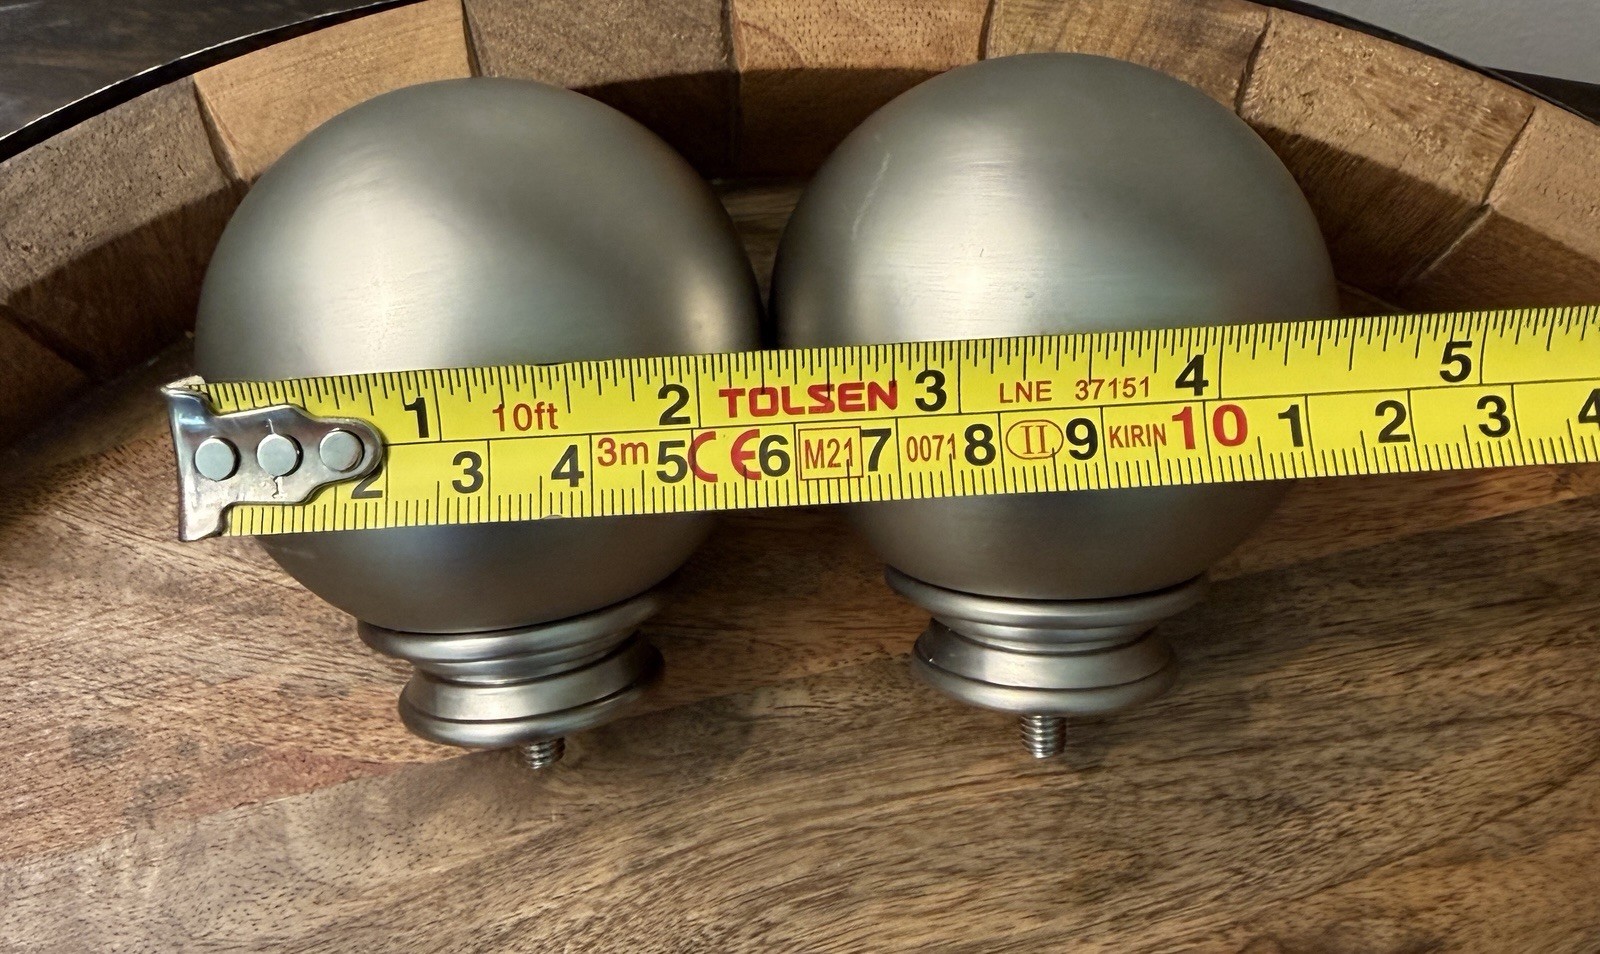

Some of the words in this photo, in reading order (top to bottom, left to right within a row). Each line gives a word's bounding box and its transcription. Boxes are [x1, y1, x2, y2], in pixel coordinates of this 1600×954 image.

[1175, 354, 1209, 397] 4
[1439, 340, 1473, 383] 5
[657, 383, 691, 426] 2
[719, 380, 898, 419] TOLSEN
[914, 369, 947, 412] 3
[1000, 379, 1053, 404] LNE
[1075, 376, 1150, 401] 37151
[404, 397, 430, 439] 1
[492, 401, 559, 433] 10ft
[1109, 423, 1167, 449] KIRIN
[1171, 403, 1249, 451] 10
[1277, 404, 1304, 448] 1
[1374, 399, 1411, 444] 2
[1476, 395, 1511, 438] 3
[596, 436, 649, 467] 3m
[758, 434, 791, 478] 6
[804, 436, 854, 470] M21
[861, 428, 892, 472] 7
[906, 433, 957, 463] 0071
[964, 423, 997, 467] 8
[1065, 417, 1099, 461] 9
[451, 450, 484, 494] 3
[550, 444, 585, 488] 4
[655, 440, 688, 484] 5
